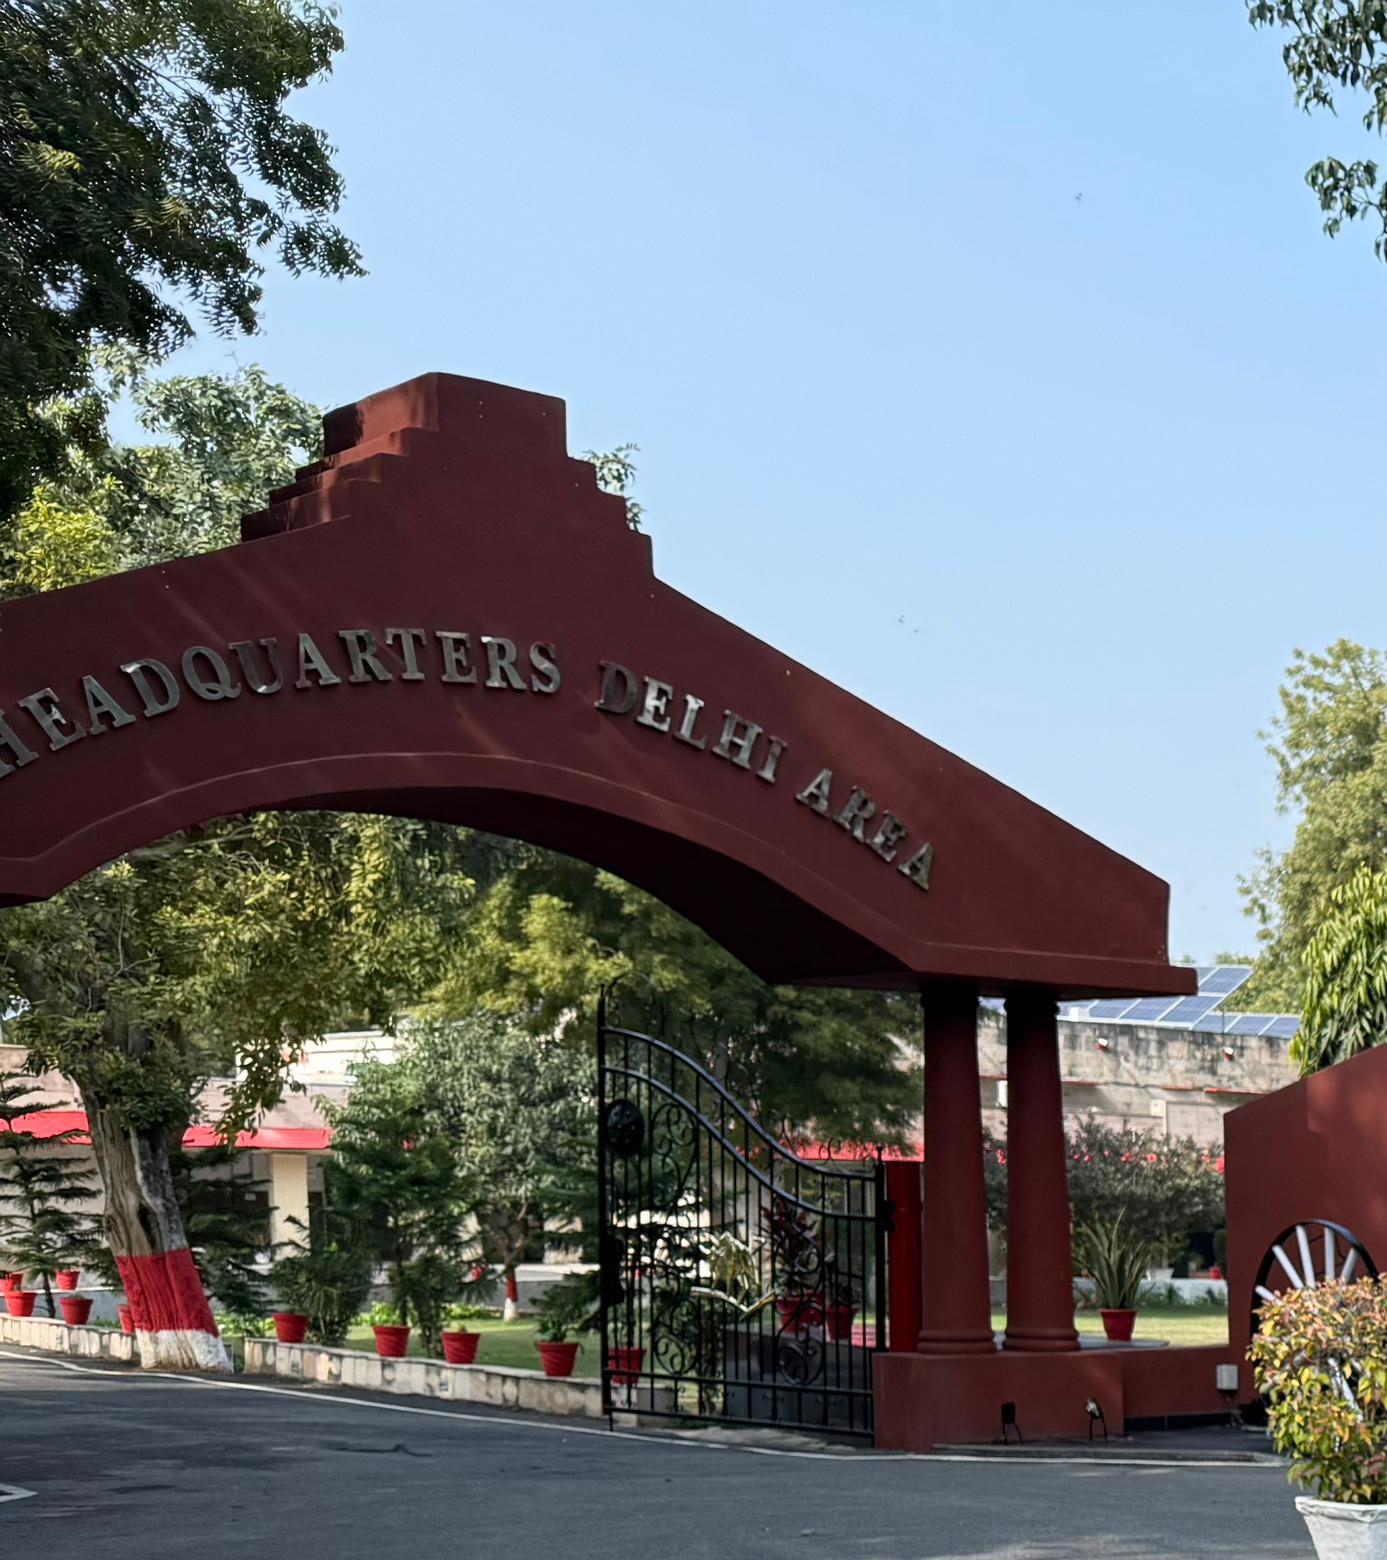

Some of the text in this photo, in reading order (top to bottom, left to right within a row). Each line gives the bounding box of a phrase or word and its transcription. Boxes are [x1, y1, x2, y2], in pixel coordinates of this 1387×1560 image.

[0, 627, 935, 890] HEADQUARTERS DELHI AREA
